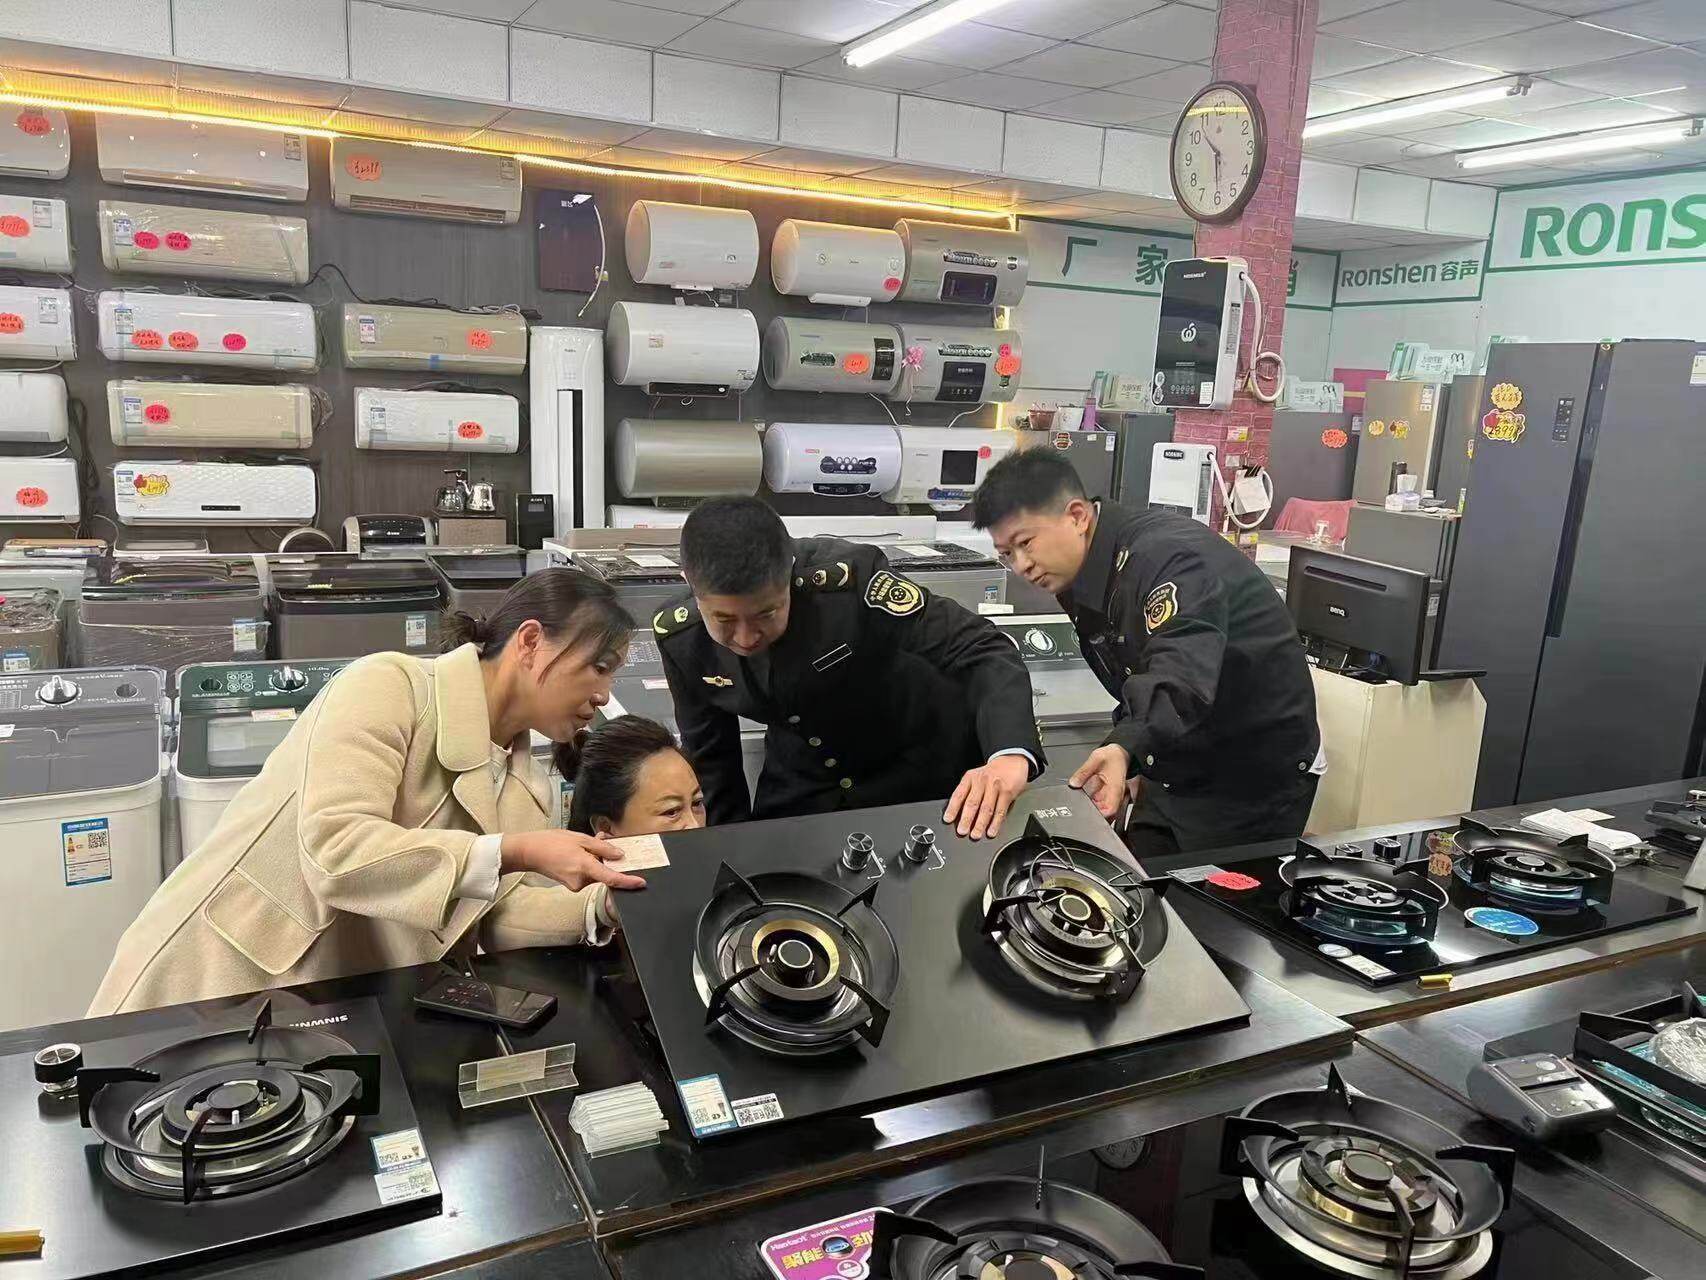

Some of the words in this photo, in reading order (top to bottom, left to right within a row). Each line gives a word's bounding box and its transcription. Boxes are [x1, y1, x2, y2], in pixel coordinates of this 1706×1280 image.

[1200, 114, 1209, 126] 11
[1240, 120, 1249, 135] 2
[1189, 130, 1202, 145] 10
[1246, 140, 1255, 156] 3
[1185, 152, 1193, 167] 9
[1241, 163, 1249, 178] 4
[1190, 172, 1197, 187] 8
[1198, 188, 1206, 202] 7
[1229, 182, 1237, 198] 5
[1213, 190, 1221, 206] 6
[1341, 262, 1436, 288] Ronshen
[1440, 259, 1479, 282] 容声
